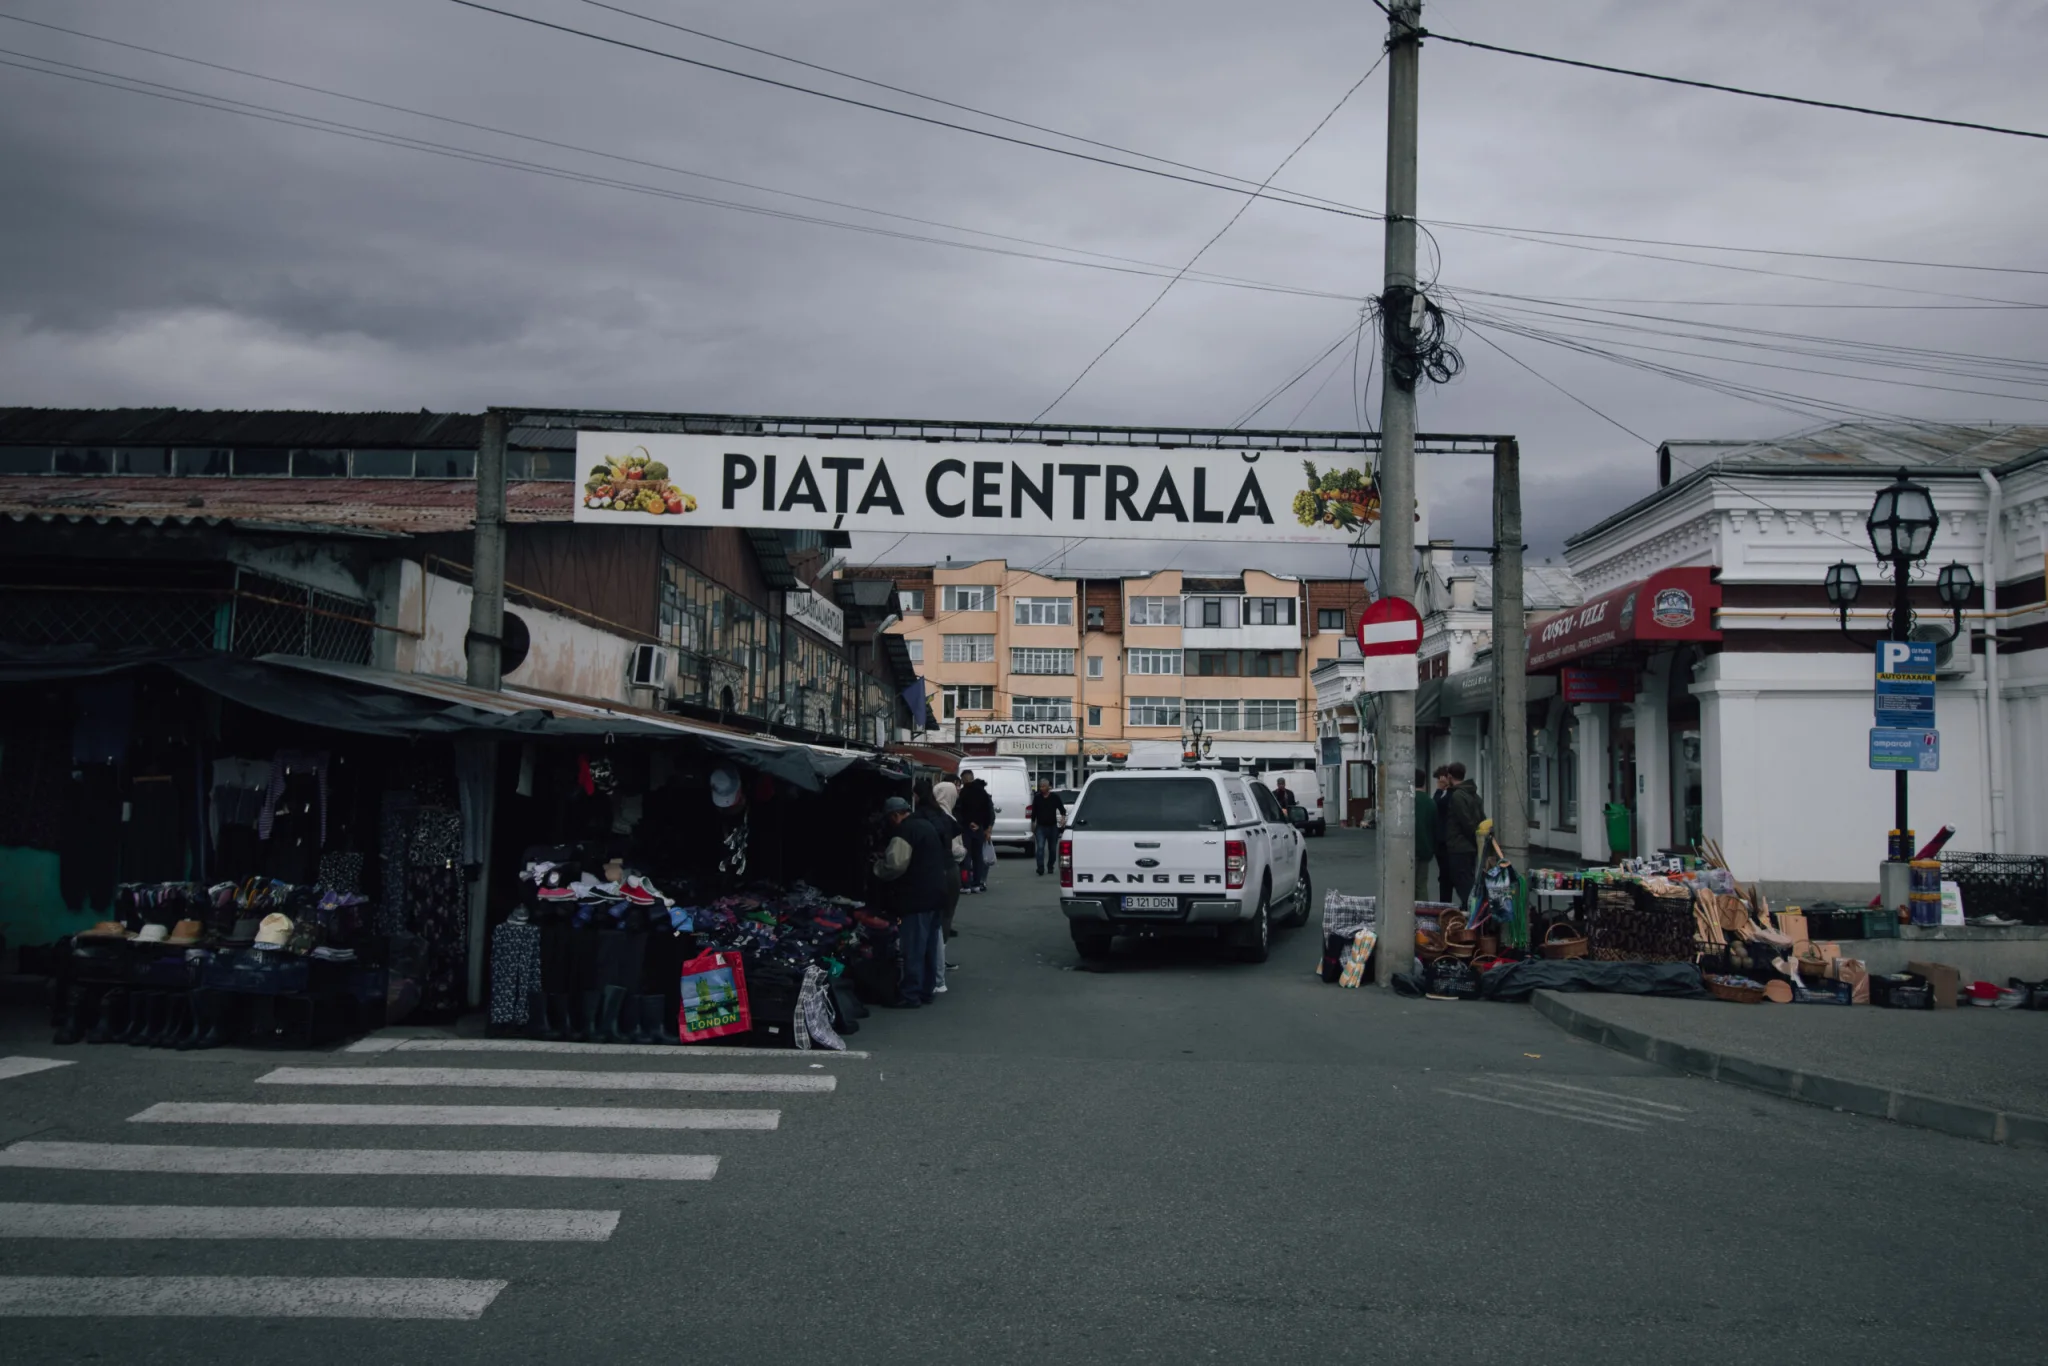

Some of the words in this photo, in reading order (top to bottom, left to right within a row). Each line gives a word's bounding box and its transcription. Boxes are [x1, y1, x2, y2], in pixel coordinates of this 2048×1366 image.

[722, 453, 904, 529] PIAȚA
[925, 452, 1275, 525] CENTRALĂ
[1883, 642, 1911, 674] P
[1880, 672, 1932, 681] AUTOTAXARE
[1012, 741, 1053, 751] Bijuterie
[1077, 873, 1222, 884] RANGER
[1126, 898, 1134, 907] B
[1137, 898, 1150, 907] 121
[1153, 898, 1175, 908] DGN
[691, 1014, 736, 1031] LONDON
